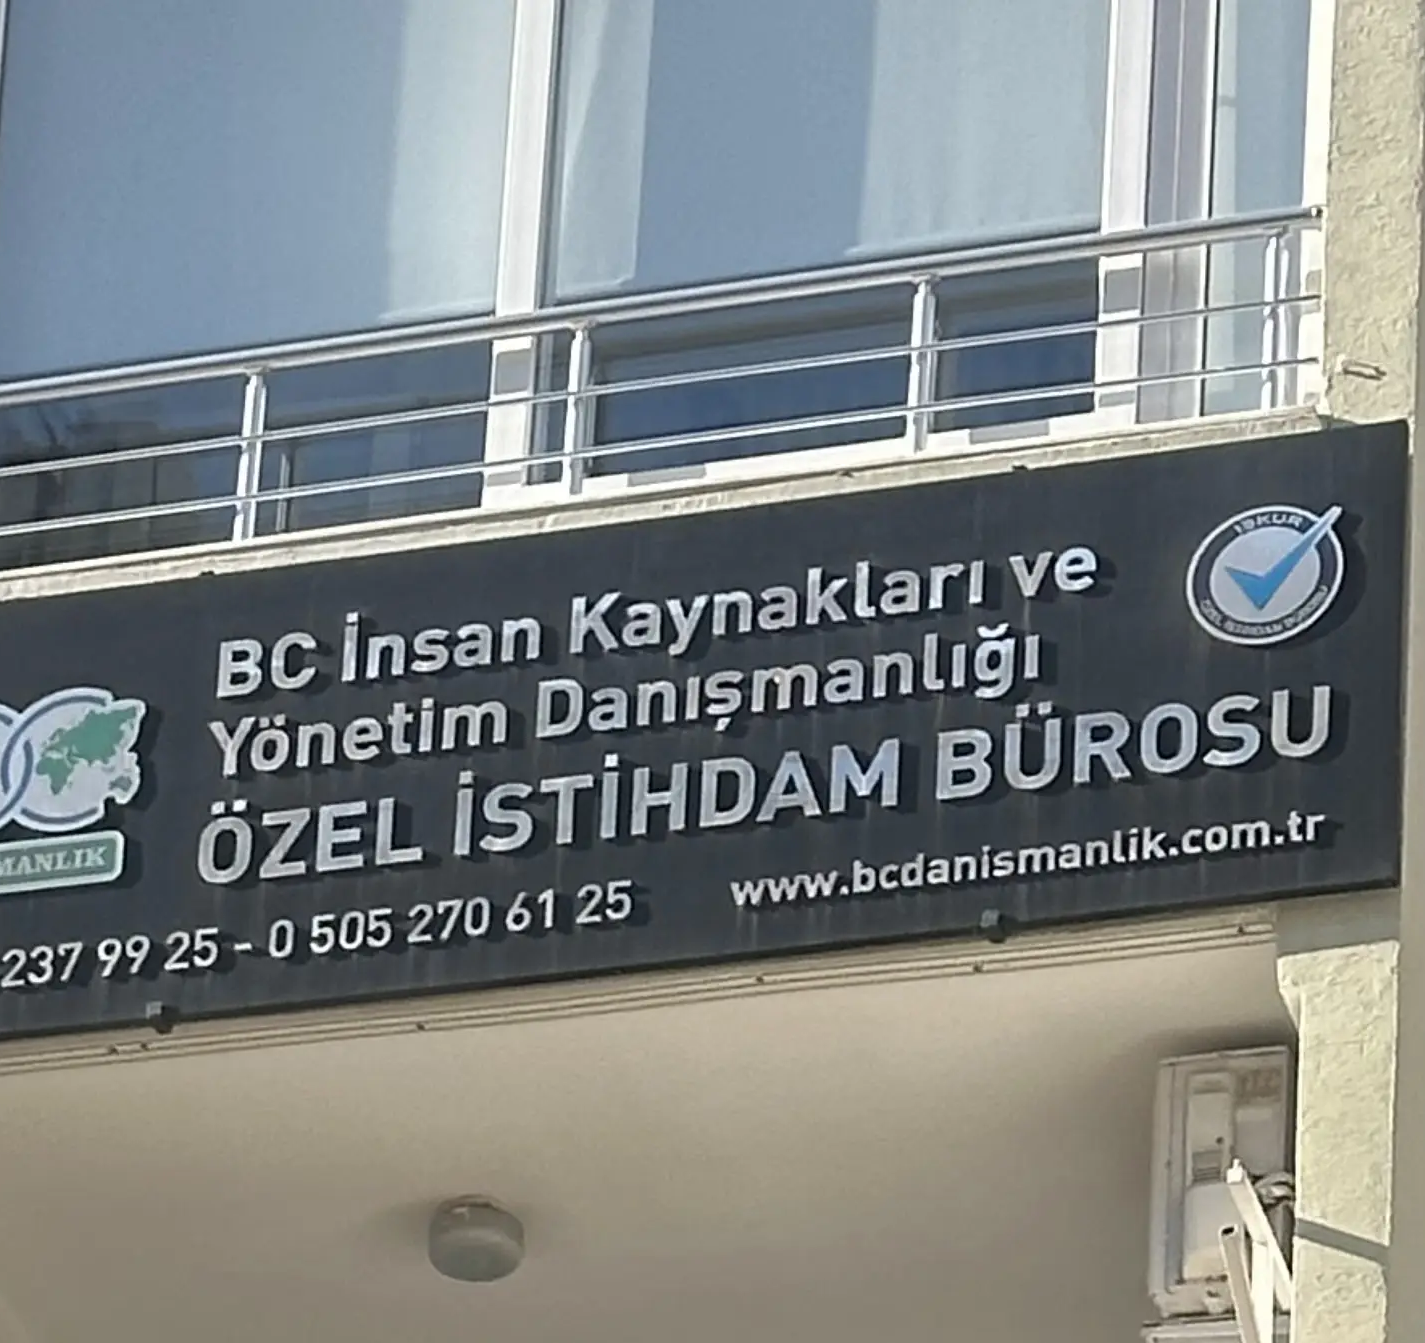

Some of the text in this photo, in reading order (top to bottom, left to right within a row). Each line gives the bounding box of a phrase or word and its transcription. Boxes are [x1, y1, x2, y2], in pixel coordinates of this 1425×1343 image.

[217, 548, 1096, 698] BC İnsan Kaynakları ve
[209, 623, 1039, 777] Yönetim Danışmanlığı
[198, 686, 1330, 883] ÖZEL İSTİHDAM BÜROSU
[731, 811, 1325, 906] www.bcdanismanlik.com.tr
[1, 942, 83, 987] 237
[98, 936, 149, 977] 99
[164, 928, 218, 970] 25
[269, 920, 293, 957] 0
[310, 908, 392, 953] 505
[408, 897, 489, 943] 270
[506, 889, 553, 931] 61
[576, 880, 631, 924] 25
